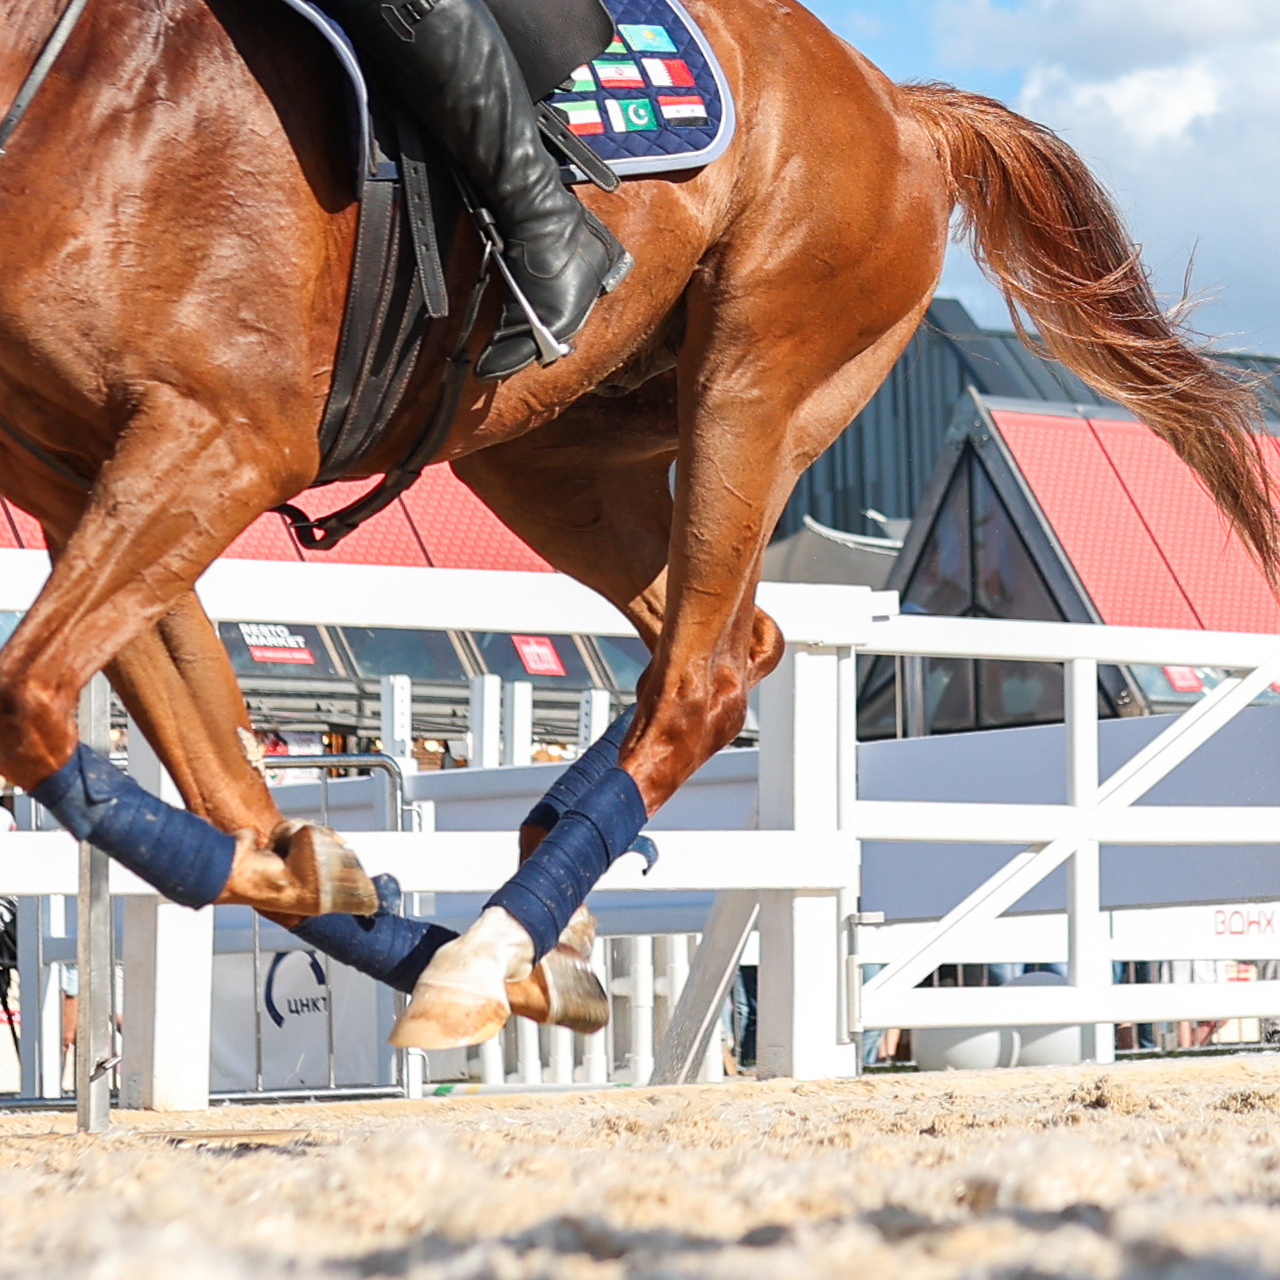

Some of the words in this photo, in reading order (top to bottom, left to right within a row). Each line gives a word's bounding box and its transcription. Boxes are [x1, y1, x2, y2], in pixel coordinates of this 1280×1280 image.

[238, 623, 290, 637] RESTO
[244, 634, 306, 648] MARKET
[1215, 910, 1275, 935] ВДНХ
